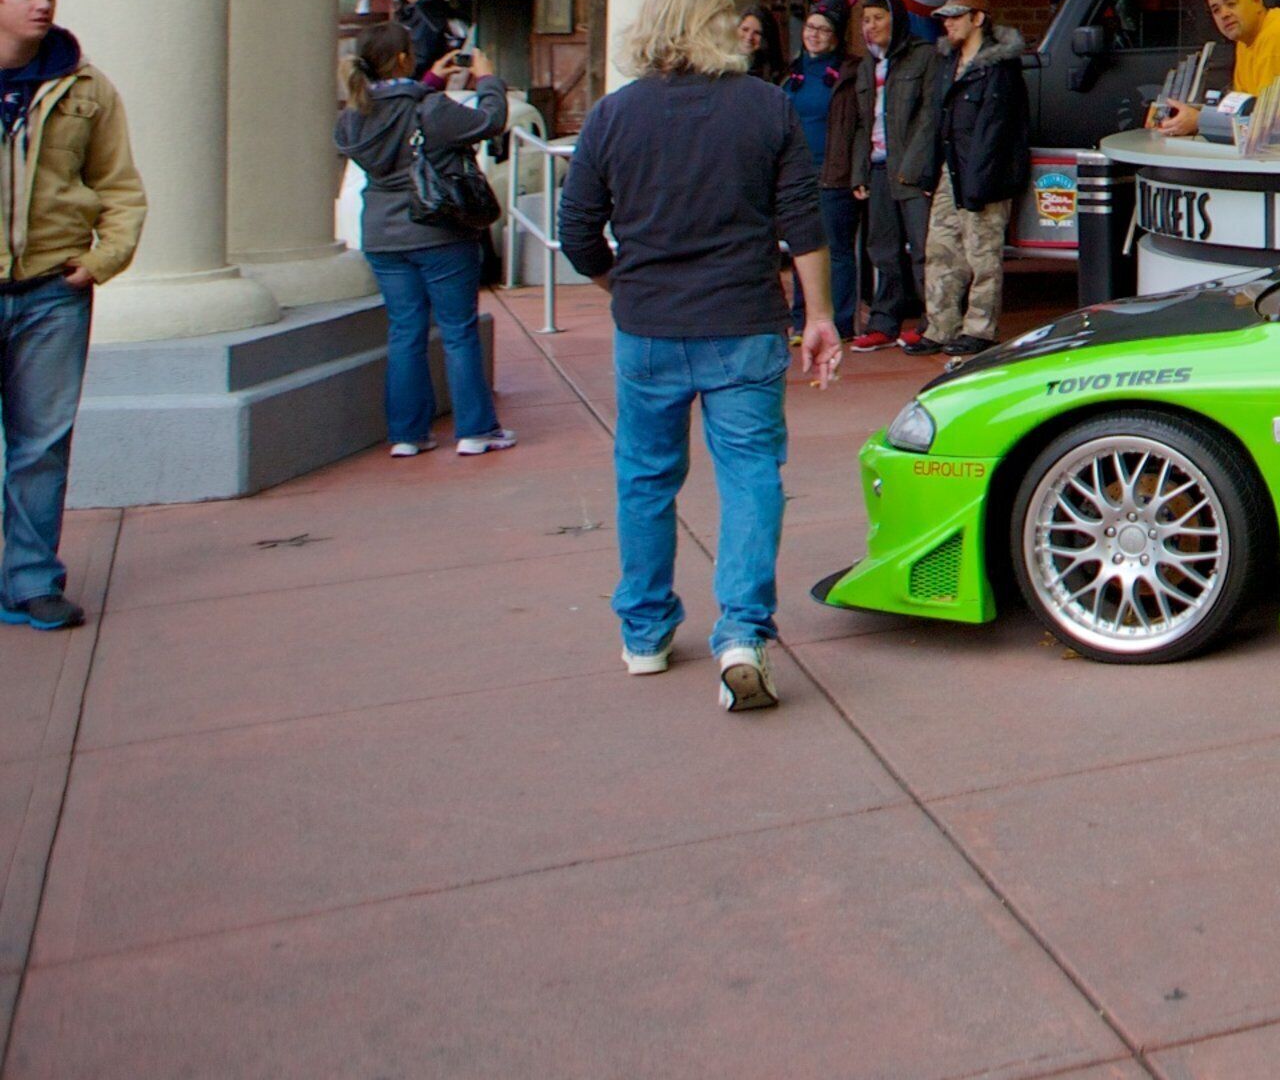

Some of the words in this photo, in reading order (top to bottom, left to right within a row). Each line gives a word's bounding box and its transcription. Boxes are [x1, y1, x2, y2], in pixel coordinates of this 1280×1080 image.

[1040, 190, 1073, 203] Star
[1138, 180, 1212, 240] TICKETS
[1046, 372, 1111, 396] TOYO
[1115, 367, 1193, 388] TIRES
